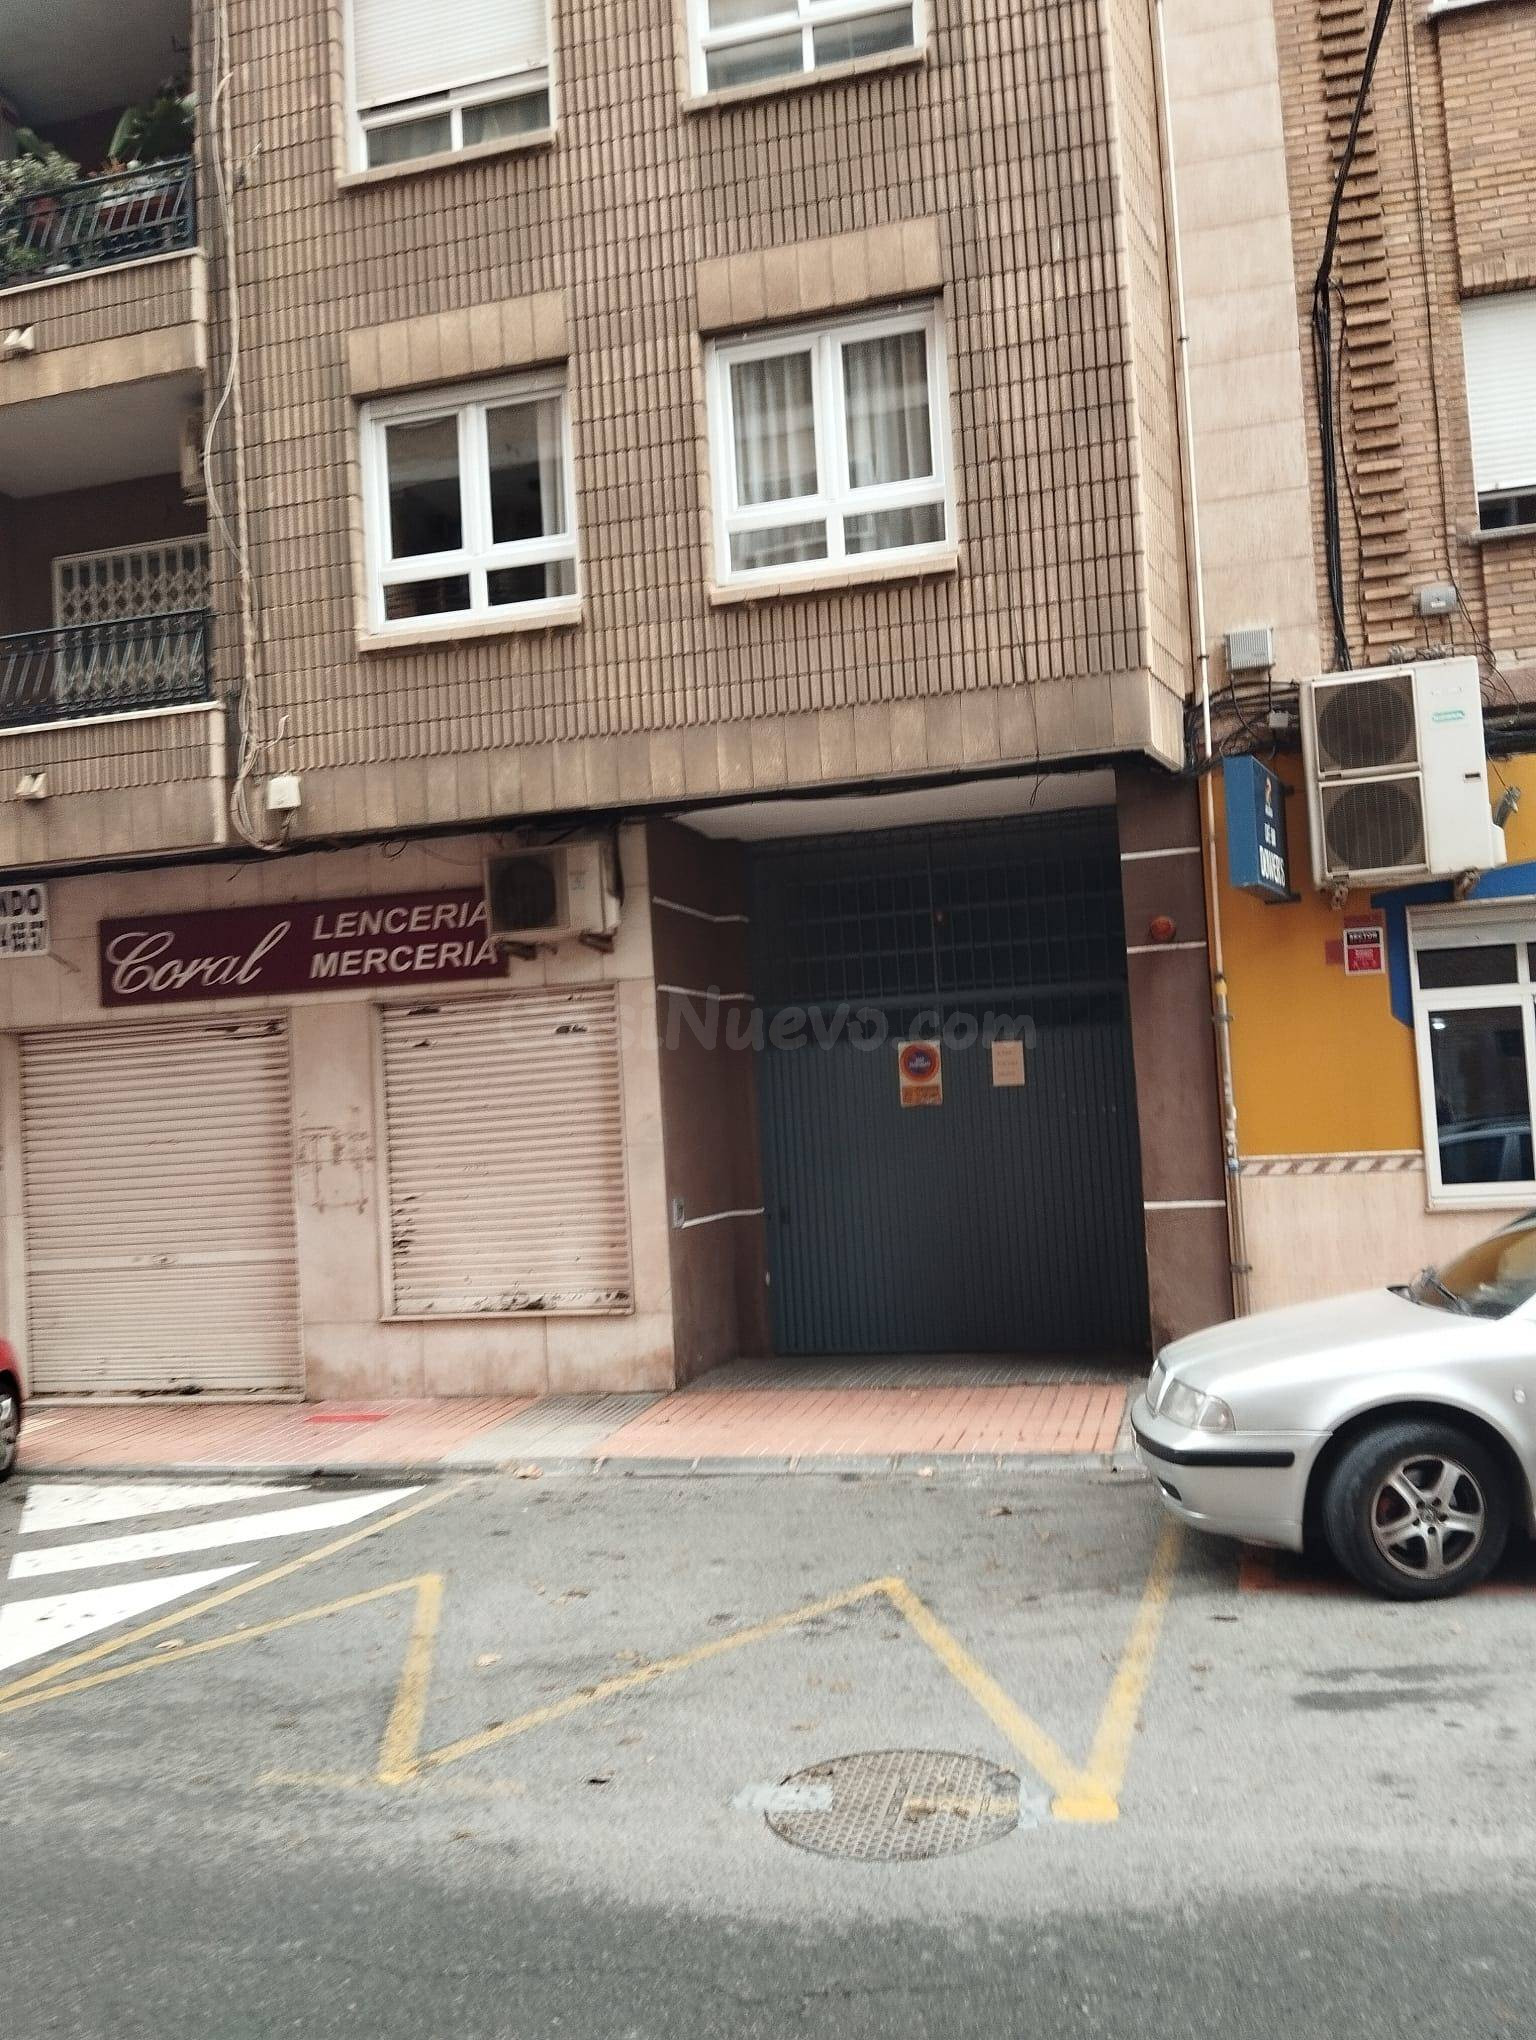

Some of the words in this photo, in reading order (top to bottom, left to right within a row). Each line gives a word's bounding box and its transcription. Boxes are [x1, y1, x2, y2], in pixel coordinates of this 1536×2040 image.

[313, 900, 490, 940] LENCERIA
[107, 920, 291, 994] Coral
[310, 938, 499, 979] MERCERIA
